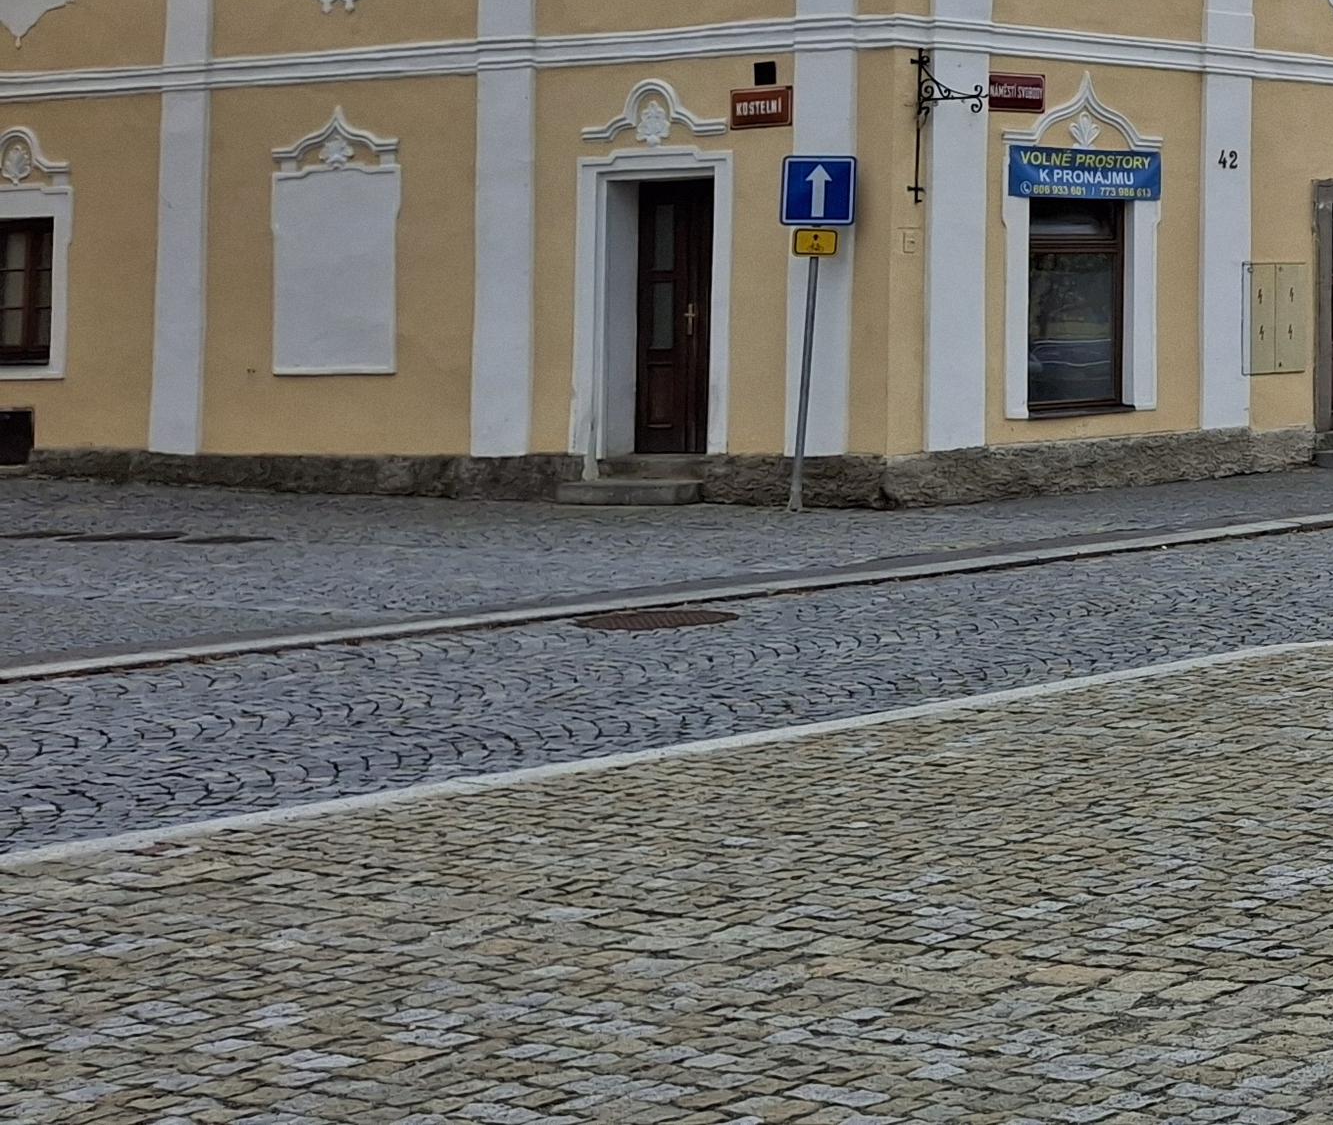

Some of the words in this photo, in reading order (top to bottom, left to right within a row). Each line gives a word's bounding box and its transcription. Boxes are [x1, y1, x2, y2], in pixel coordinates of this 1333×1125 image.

[736, 96, 782, 116] KOSTELNÍ
[1020, 150, 1072, 167] VOLNÉ
[1075, 154, 1151, 169] PROSTORY
[1218, 149, 1238, 169] 42
[1039, 169, 1050, 182] K
[1053, 167, 1134, 185] PRONÁJMU
[1100, 186, 1116, 196] 773
